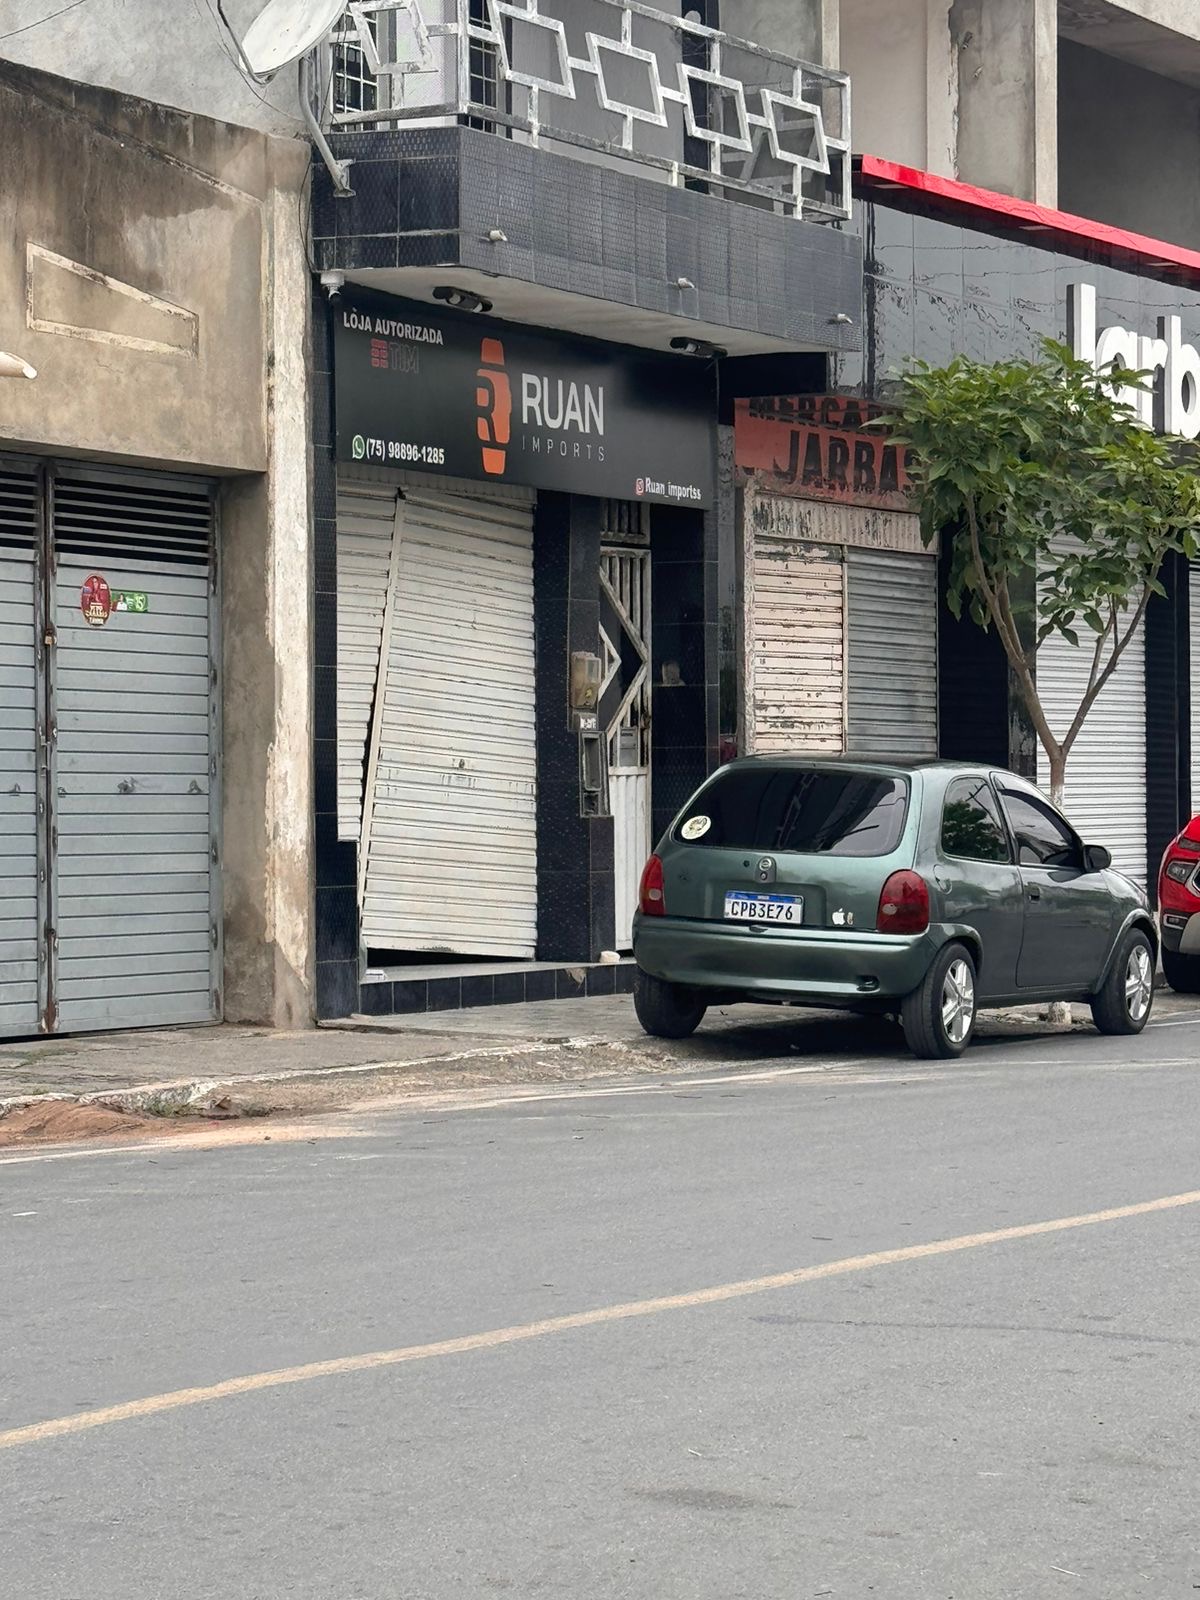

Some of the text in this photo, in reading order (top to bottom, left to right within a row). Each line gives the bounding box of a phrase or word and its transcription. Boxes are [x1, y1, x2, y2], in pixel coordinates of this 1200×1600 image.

[343, 311, 444, 345] LOJA AUTORIZADA
[389, 342, 419, 374] TIM
[521, 372, 604, 435] RUAN
[366, 438, 444, 464] (75) 98896-1285
[522, 435, 605, 461] IMPORTS
[645, 476, 702, 500] Ruan_importss
[731, 901, 792, 920] CPB3E76
